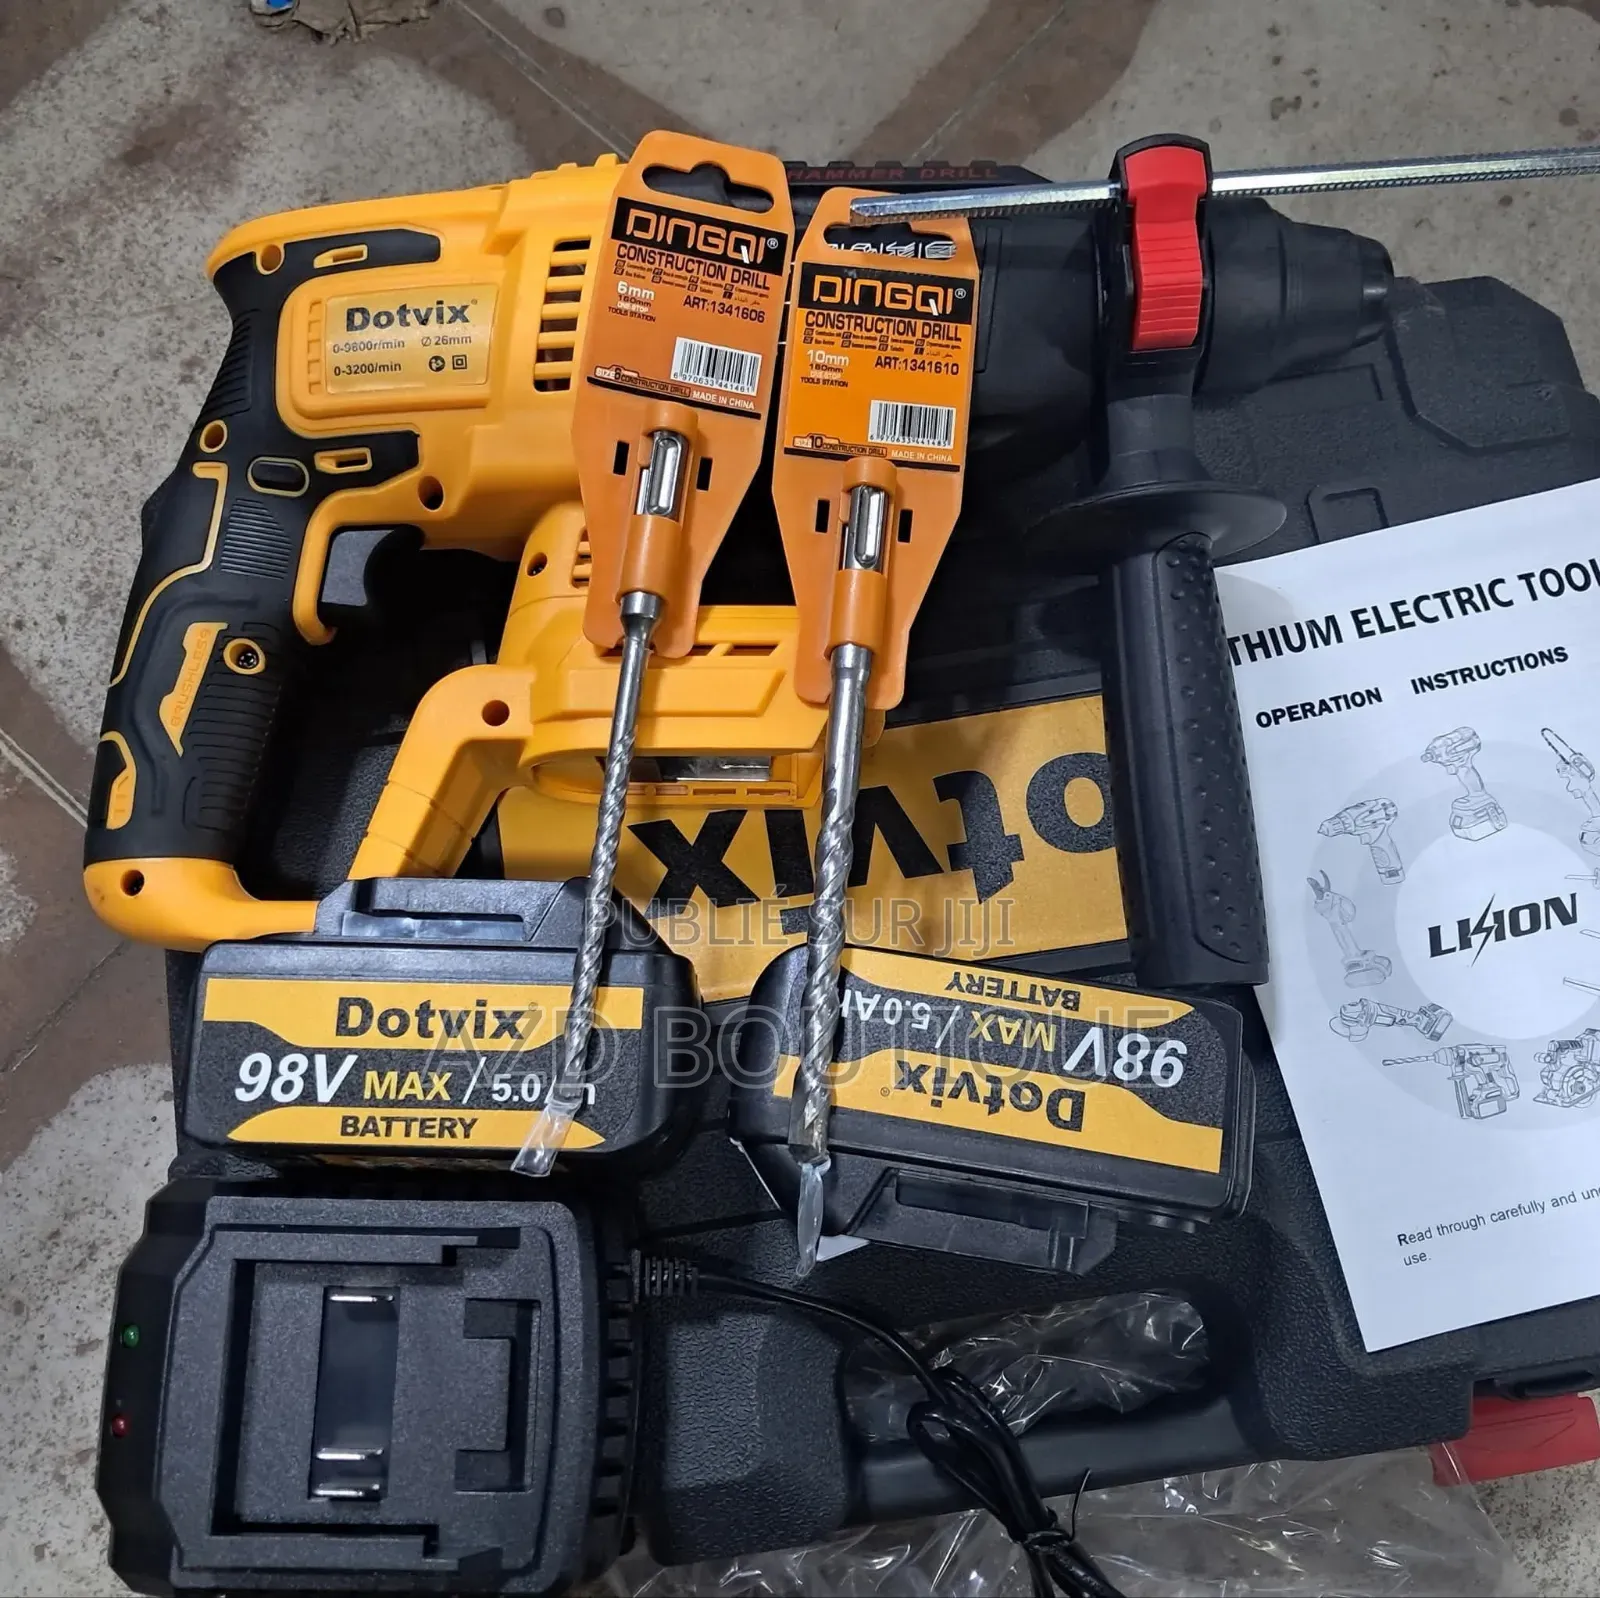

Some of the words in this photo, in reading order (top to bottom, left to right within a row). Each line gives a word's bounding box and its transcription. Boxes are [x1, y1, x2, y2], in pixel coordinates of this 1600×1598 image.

[919, 167, 999, 180] DRILL
[617, 243, 727, 281] CONSTRUCTION
[731, 267, 770, 291] DRILL
[617, 280, 655, 301] 6mm
[346, 300, 471, 332] Dotvix
[608, 306, 629, 317] TOOLS
[629, 310, 657, 323] STATION
[683, 294, 766, 323] ART:1341606
[805, 311, 917, 337] CONSTRUCTION
[921, 321, 962, 342] DRILL
[334, 360, 402, 377] 0-3200/min
[807, 349, 850, 367] 10mm
[875, 355, 960, 376] ART:1341610
[620, 374, 669, 392] CONSTRUCTION
[801, 376, 820, 385] TOOLS
[822, 378, 849, 388] STATION
[693, 390, 717, 403] MADE
[719, 395, 728, 405] IN
[729, 397, 755, 410] CHINA
[891, 449, 915, 460] MADE
[917, 452, 926, 461] IN
[927, 453, 953, 463] CHINA
[1226, 614, 1344, 667] THIUM
[1350, 577, 1515, 639] ELECTRIC
[1255, 687, 1384, 729] OPERATION
[1410, 646, 1570, 695] INSTRUCTIONS
[944, 971, 1081, 1012] BATTERY
[335, 995, 527, 1040] Dotvix
[969, 1010, 1057, 1052] MAX
[1062, 1026, 1188, 1088] 98V
[234, 1052, 358, 1104] 98V
[363, 1069, 452, 1101] MAX
[893, 1059, 1086, 1133] Dotvix
[340, 1115, 479, 1139] BATTERY
[1397, 1227, 1433, 1247] Read
[1436, 1214, 1486, 1237] through
[1490, 1200, 1546, 1223] carefully
[1550, 1190, 1577, 1208] and
[1581, 1186, 1600, 1200] un
[1403, 1251, 1432, 1267] use.
